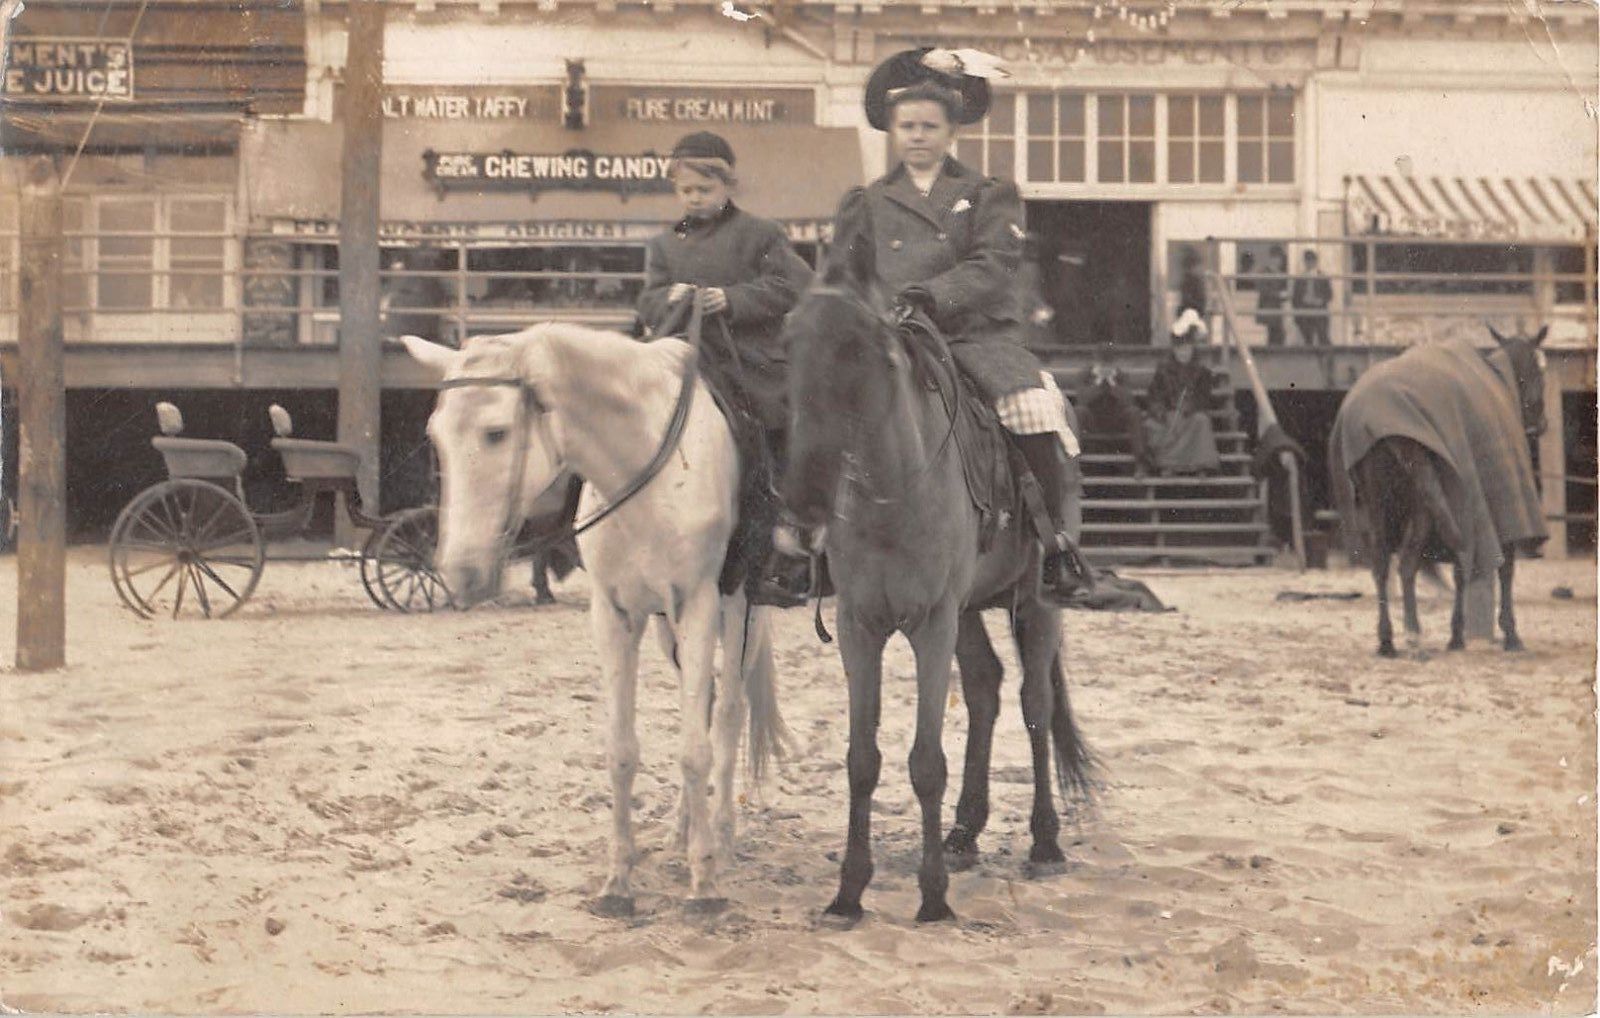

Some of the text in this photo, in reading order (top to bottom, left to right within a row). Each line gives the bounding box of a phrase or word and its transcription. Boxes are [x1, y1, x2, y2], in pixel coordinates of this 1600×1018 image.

[33, 69, 127, 92] JUICE
[414, 95, 470, 119] WATER
[473, 96, 528, 119] TAFFY
[626, 97, 775, 120] PURE CREAM MINT
[484, 155, 672, 179] CHEWING CANDY
